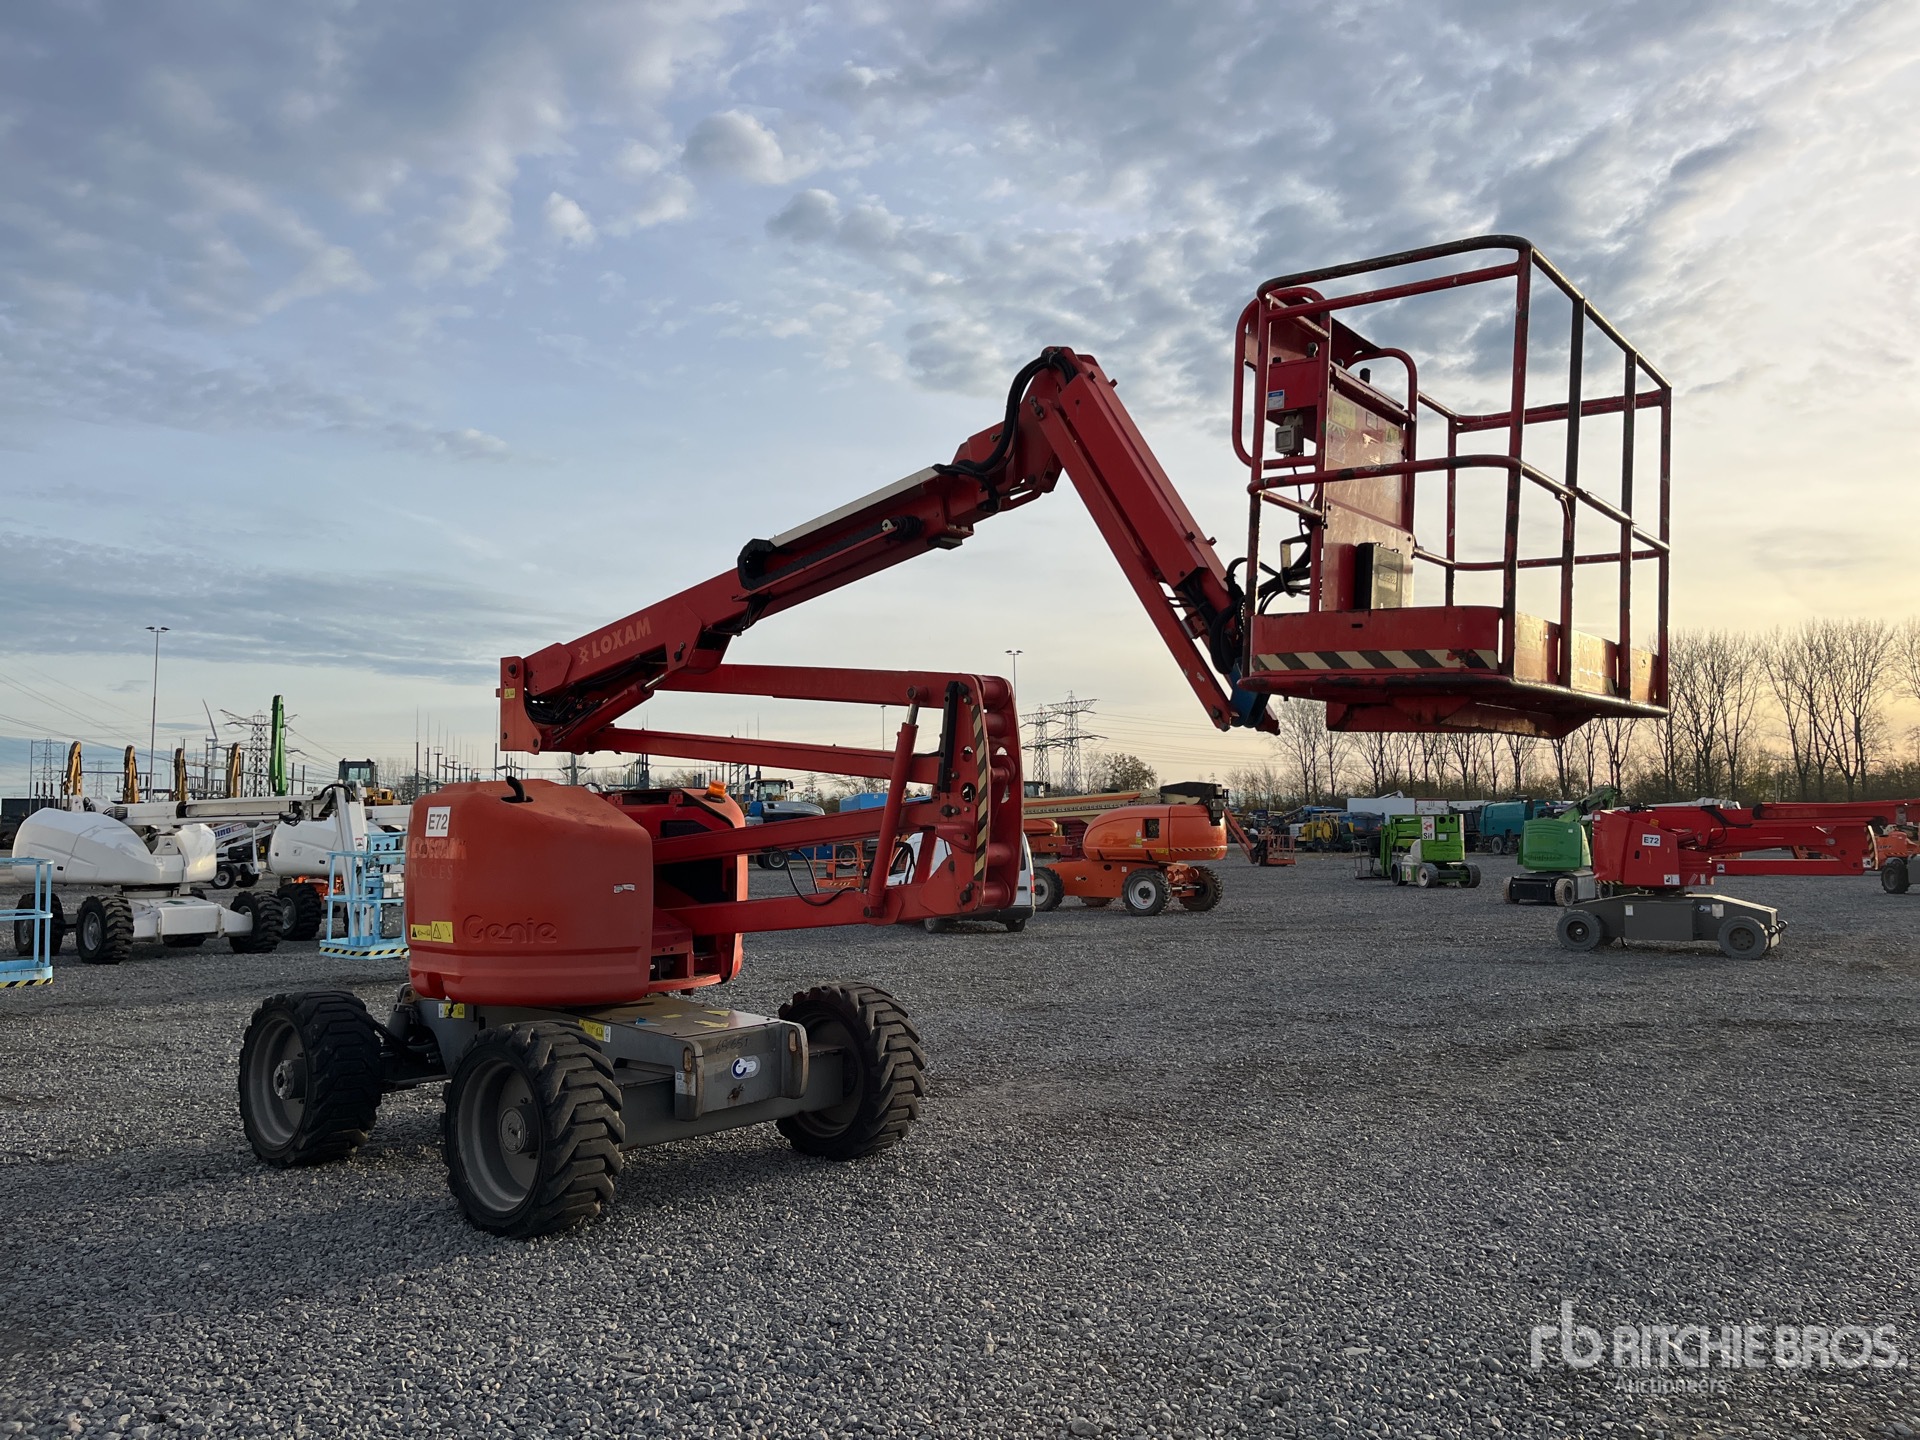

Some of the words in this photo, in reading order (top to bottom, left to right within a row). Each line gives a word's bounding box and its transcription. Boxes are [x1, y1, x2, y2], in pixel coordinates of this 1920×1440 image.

[592, 617, 651, 659] LOXAM
[428, 813, 448, 830] E72
[1643, 836, 1660, 845] E72
[463, 914, 557, 944] Genie
